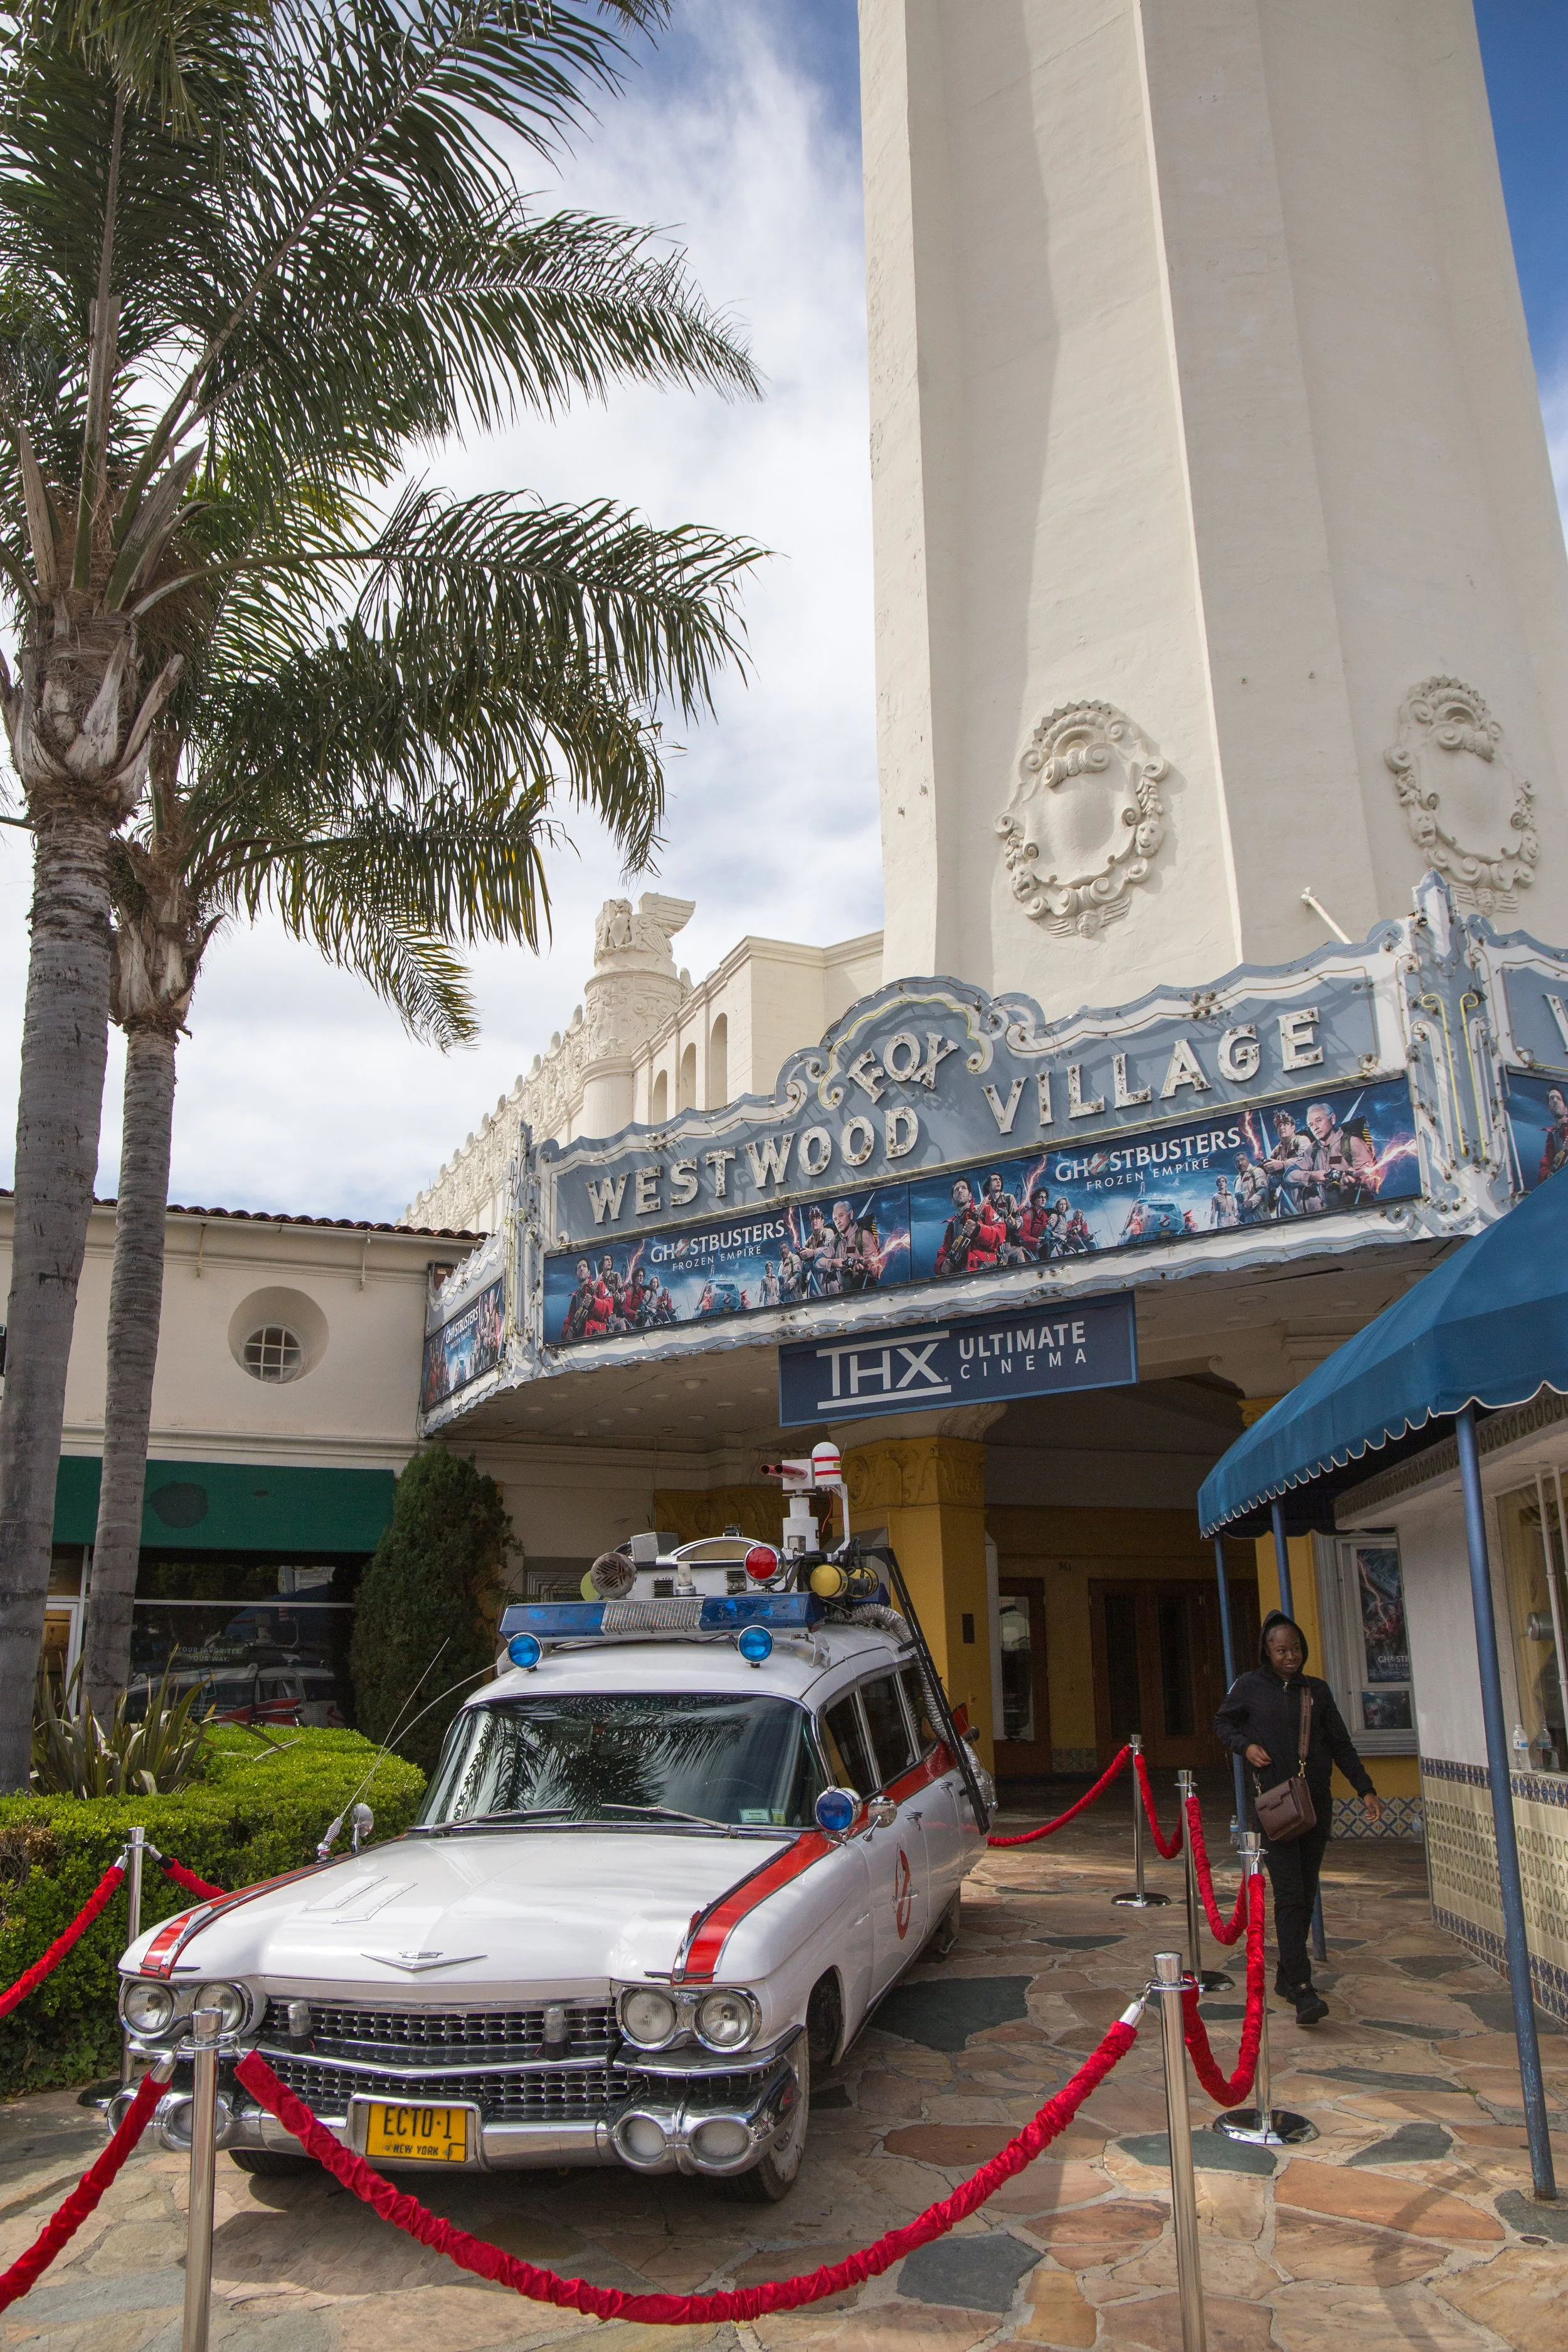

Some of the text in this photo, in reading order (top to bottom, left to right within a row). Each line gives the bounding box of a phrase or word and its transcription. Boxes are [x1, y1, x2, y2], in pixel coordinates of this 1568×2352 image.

[846, 1032, 960, 1104] FOX
[585, 1007, 1324, 1224] WESTWOOD VILLAGE
[1055, 1127, 1241, 1182] GHOSTBUSTERS
[1087, 1158, 1209, 1190] FROZEN EMPIRE
[650, 1220, 785, 1263] GHOSTBUSTERS
[672, 1246, 761, 1271] FROZEN EMPIRE
[959, 1321, 1086, 1360] ULTIMATE
[817, 1330, 950, 1397] THX
[960, 1348, 1086, 1379] CINEMA
[1059, 1561, 1071, 1571] 961
[393, 2144, 439, 2156] NEW YORK
